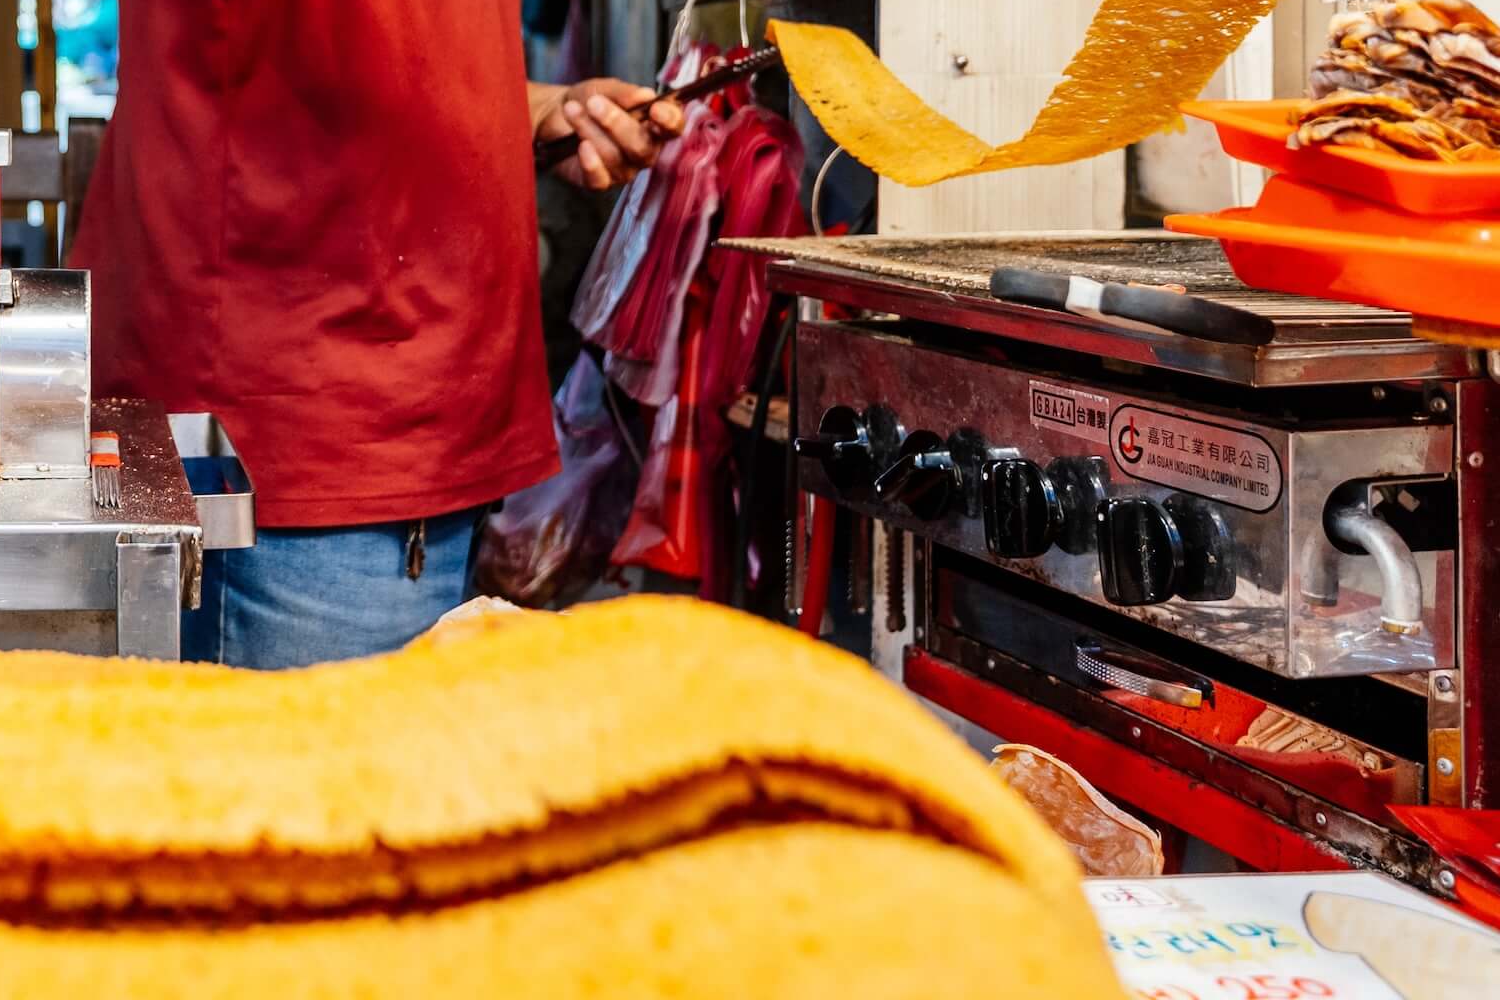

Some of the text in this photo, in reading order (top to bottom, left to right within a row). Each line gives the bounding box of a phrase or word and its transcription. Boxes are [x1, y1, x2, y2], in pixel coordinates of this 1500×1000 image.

[1036, 395, 1072, 421] GBA24
[1147, 426, 1270, 474] 嘉冠工業有限公司
[1174, 460, 1210, 481] INDUSTRIAL
[1210, 469, 1242, 489] COMPANY
[1243, 479, 1270, 497] LIMITED
